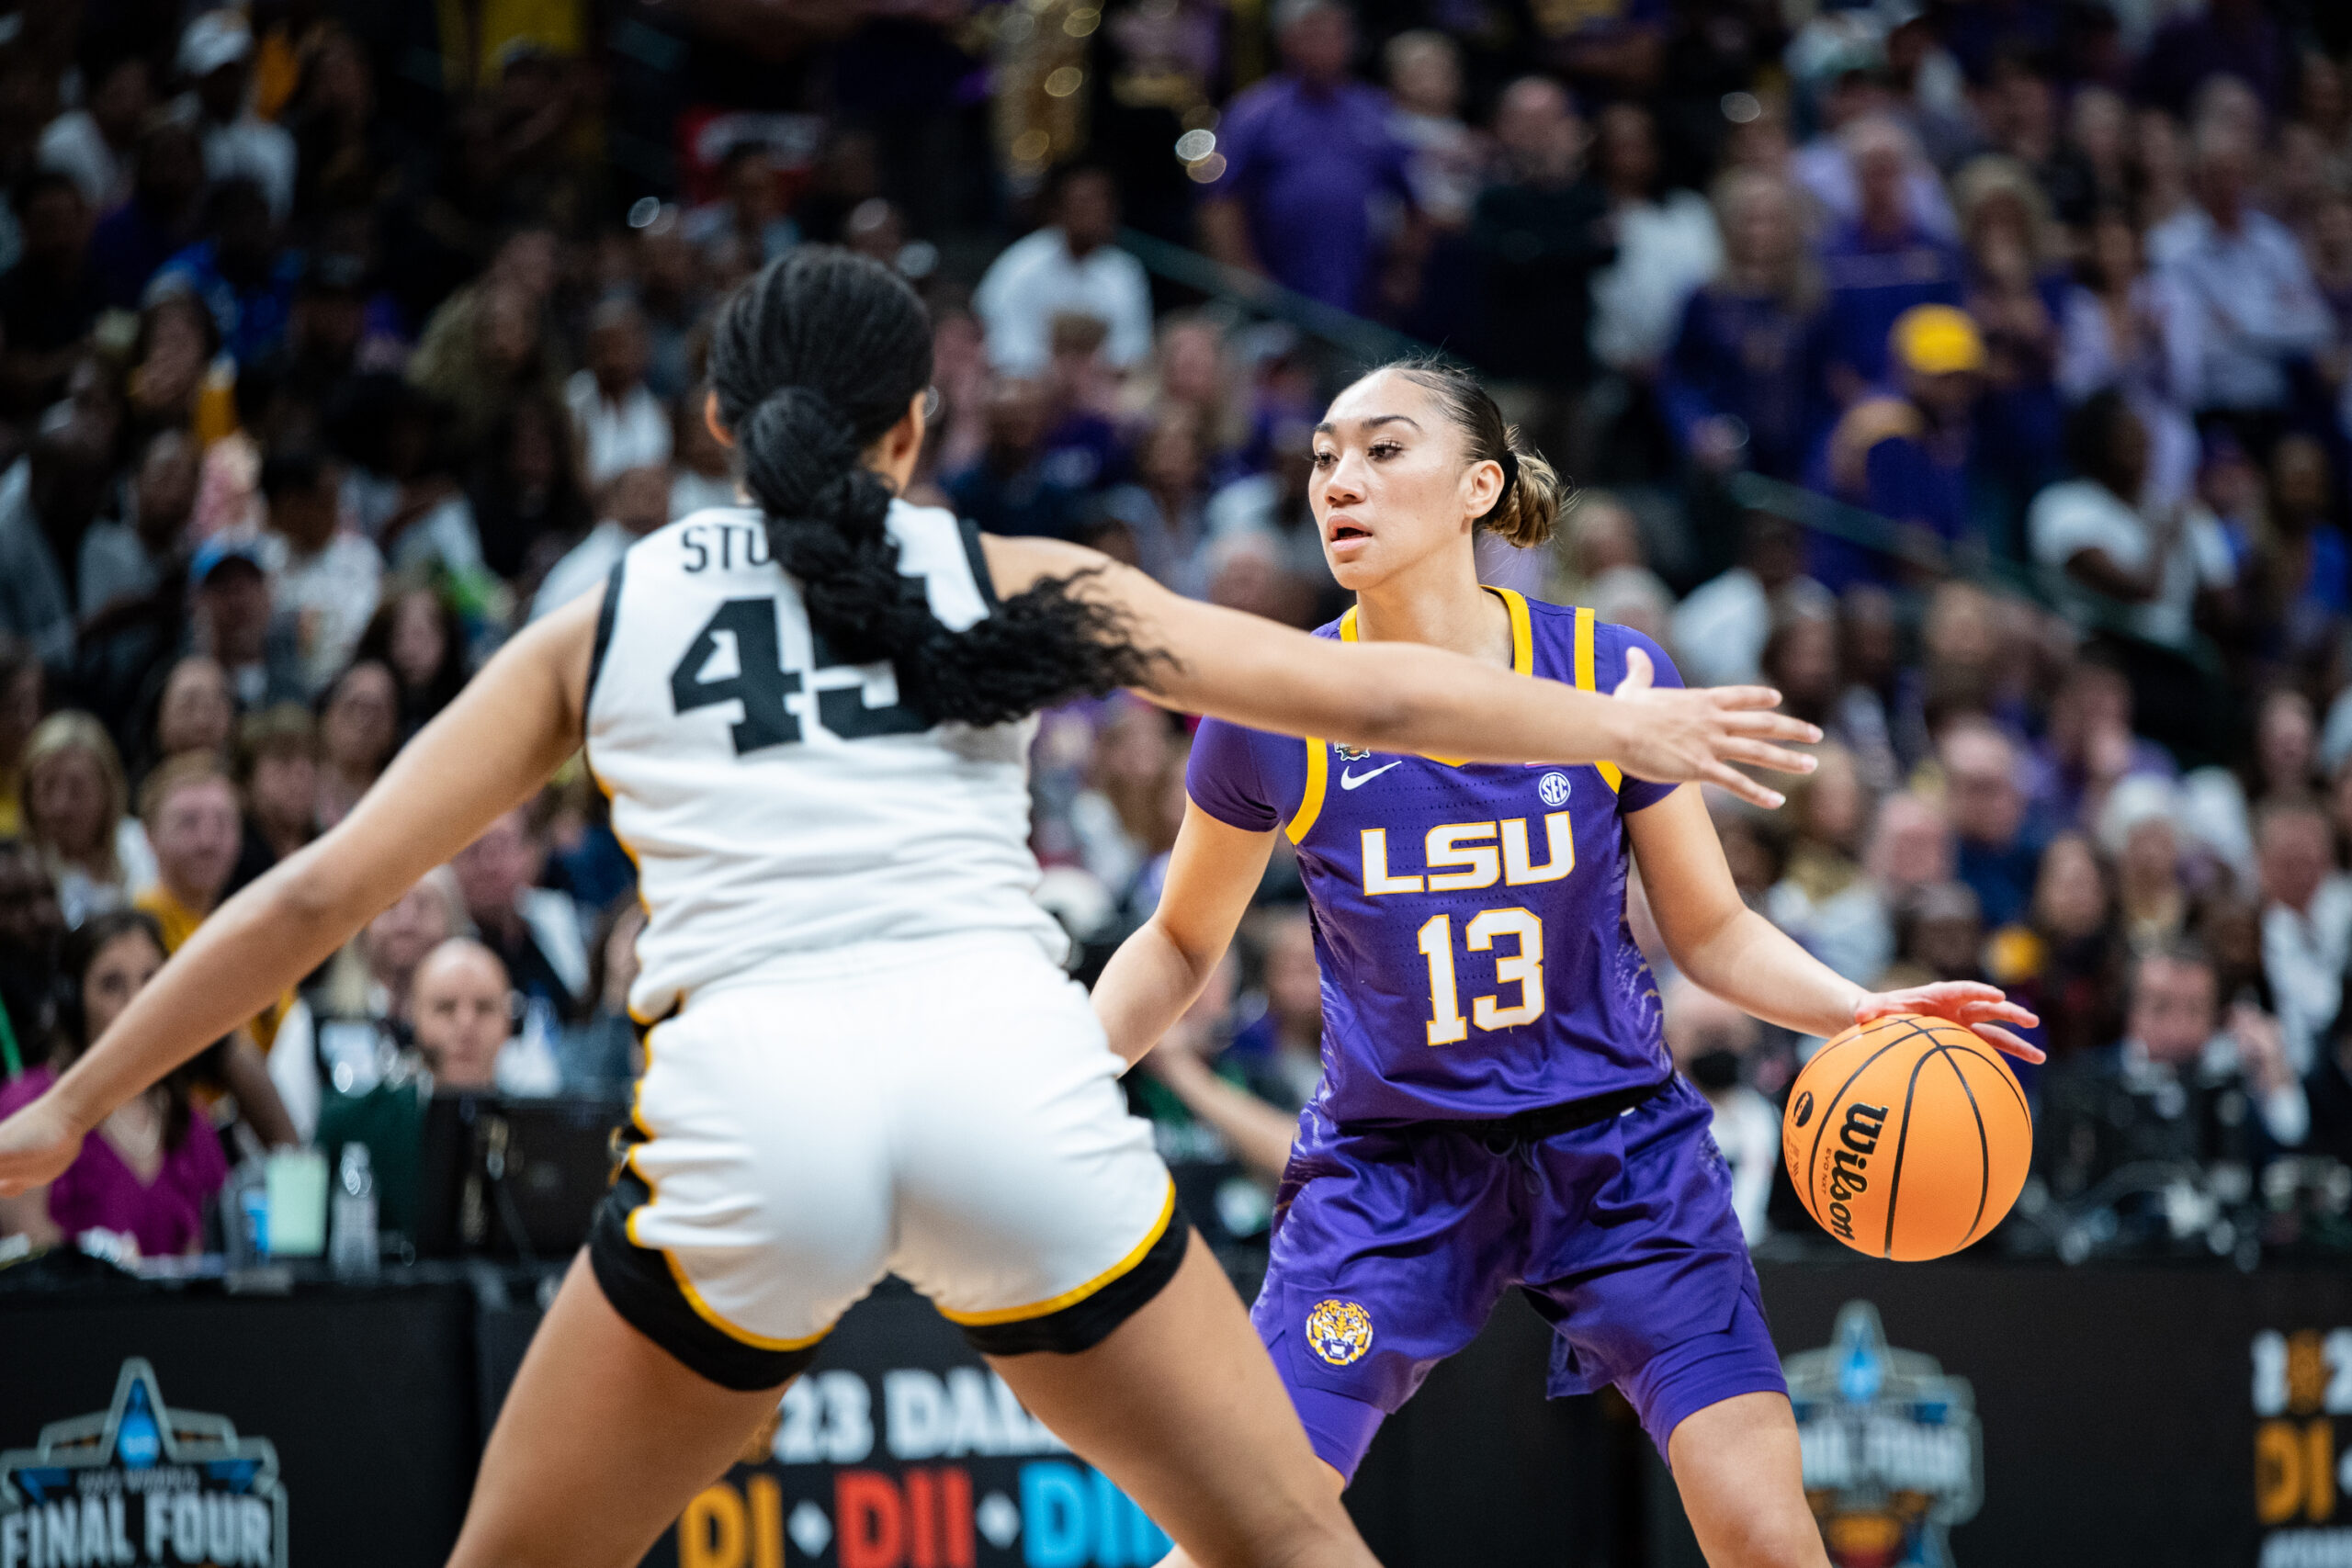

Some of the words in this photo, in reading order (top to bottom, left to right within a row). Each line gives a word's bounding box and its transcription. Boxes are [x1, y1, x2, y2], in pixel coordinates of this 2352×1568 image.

[682, 525, 771, 574] STU
[1542, 774, 1567, 804] SEC
[1360, 810, 1576, 897] LSU
[1417, 906, 1546, 1046] 13
[1821, 1173, 1829, 1195] NXT
[1823, 1147, 1833, 1171] EVO
[1829, 1101, 1889, 1241] Wilson
[746, 1368, 875, 1463] 23
[883, 1366, 1071, 1460] DAL
[2, 1495, 136, 1568] FINAL
[144, 1488, 273, 1567] FOUR
[834, 1467, 975, 1568] DII
[1019, 1462, 1177, 1568] DII
